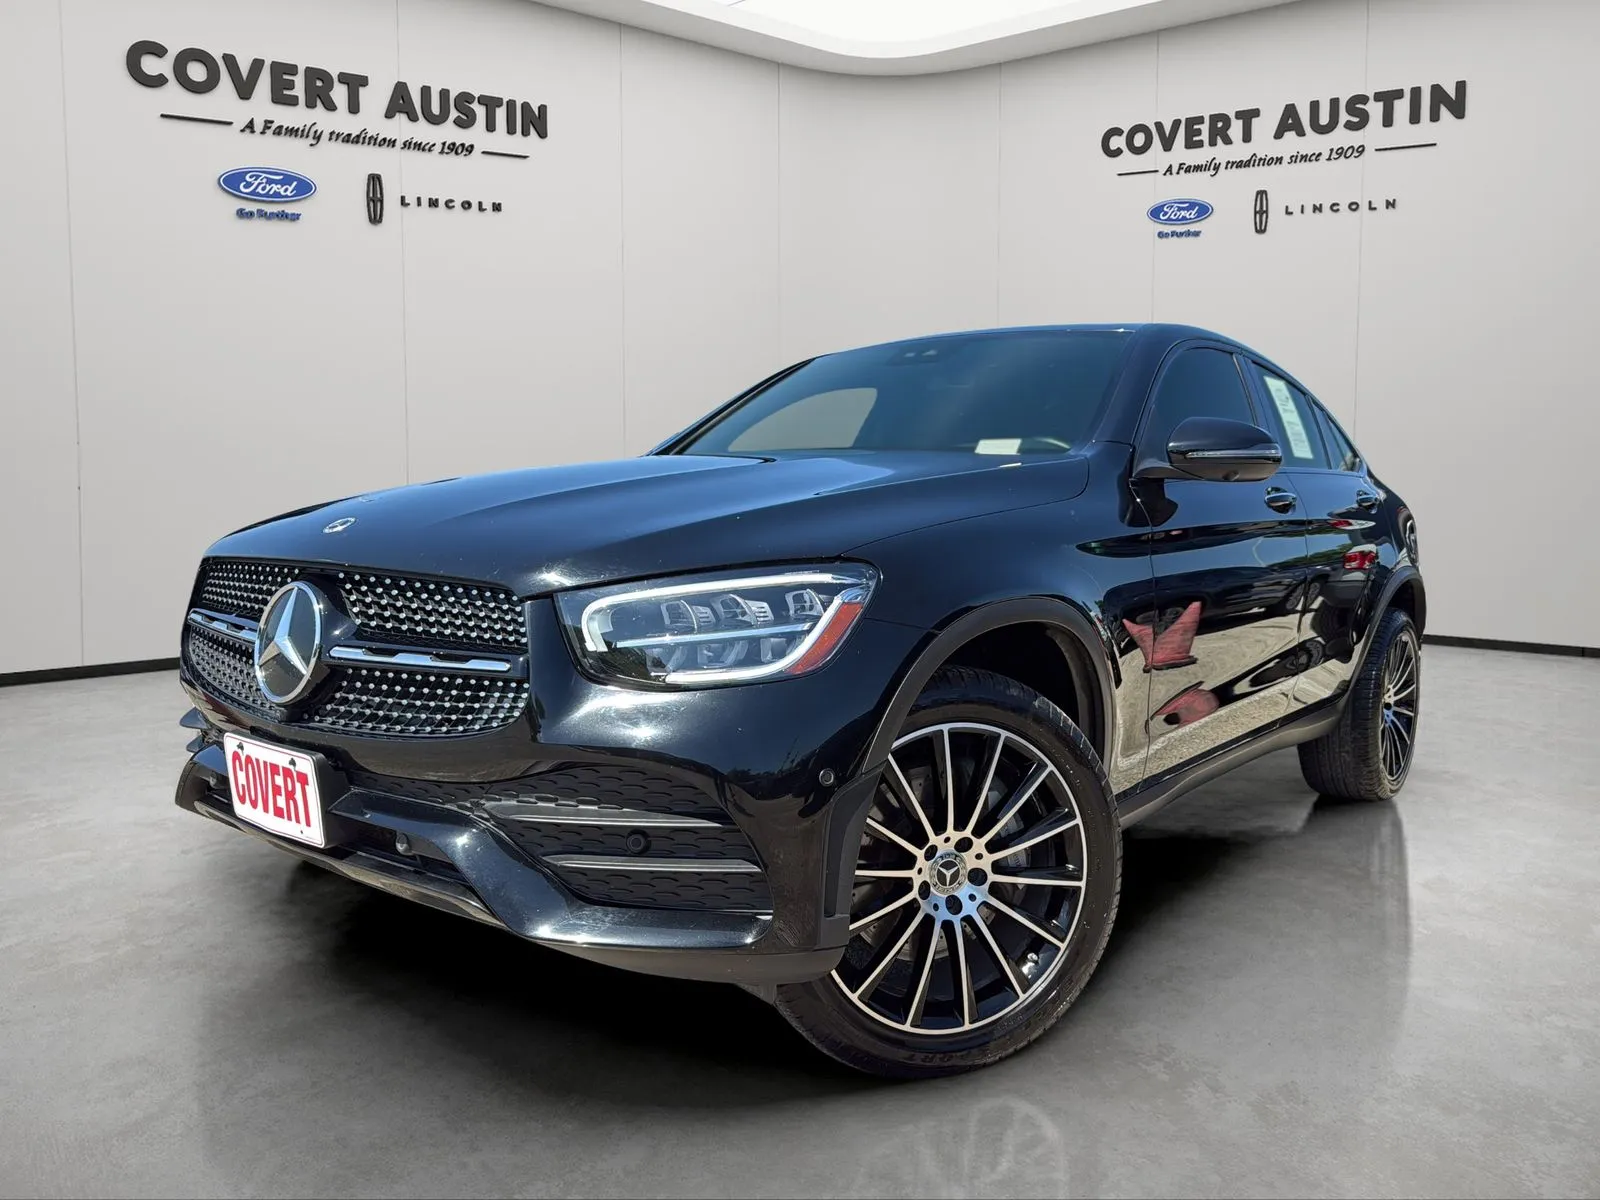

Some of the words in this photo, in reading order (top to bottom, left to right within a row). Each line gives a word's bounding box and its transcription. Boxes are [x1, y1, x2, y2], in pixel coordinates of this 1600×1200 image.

[125, 39, 369, 114] COVERT
[384, 80, 548, 140] AUSTIN
[1100, 107, 1261, 159] COVERT
[1273, 80, 1467, 141] AUSTIN
[239, 117, 256, 135] A
[259, 118, 324, 148] Family
[327, 127, 398, 149] tradition
[400, 136, 437, 153] since
[438, 140, 475, 157] 1909
[1163, 163, 1174, 177] A
[1176, 156, 1222, 178] Family
[1224, 152, 1284, 170] tradition
[1287, 150, 1323, 165] since
[1326, 144, 1366, 162] 1909
[240, 171, 298, 197] Ford
[400, 195, 503, 213] LINCOLN
[1159, 202, 1199, 220] Ford
[1284, 198, 1398, 216] LINCOLN
[231, 749, 312, 828] COVERT
